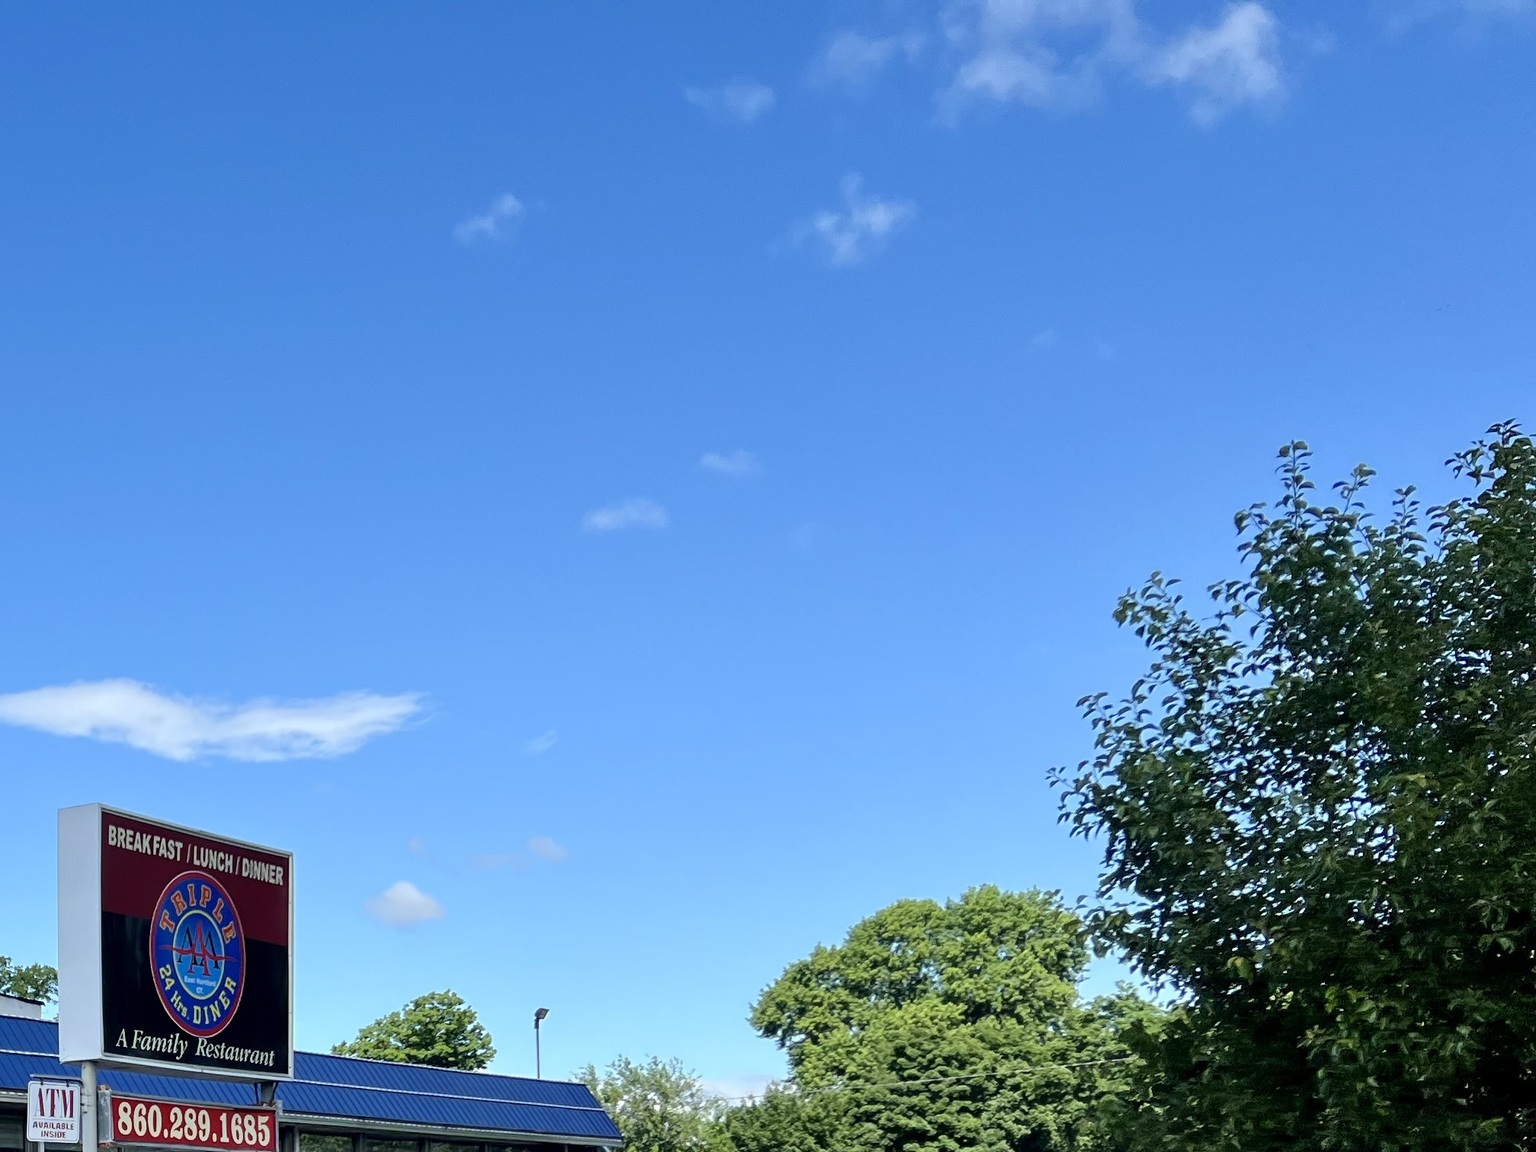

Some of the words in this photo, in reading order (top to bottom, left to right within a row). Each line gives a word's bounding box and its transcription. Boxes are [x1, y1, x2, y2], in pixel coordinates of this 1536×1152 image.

[108, 824, 183, 862] BREAKFAST
[193, 845, 233, 875] LUNCH
[242, 858, 284, 886] DINNER
[159, 883, 237, 944] TRIPLE
[159, 964, 175, 991] 24
[193, 976, 237, 1025] DINER
[116, 1028, 128, 1048] A
[132, 1029, 188, 1060] Family
[195, 1038, 276, 1067] Restaurant
[34, 1087, 75, 1119] ATM
[117, 1101, 271, 1147] 860.289.1685
[32, 1121, 75, 1131] AVAILABLE
[40, 1130, 67, 1139] INSIDE
